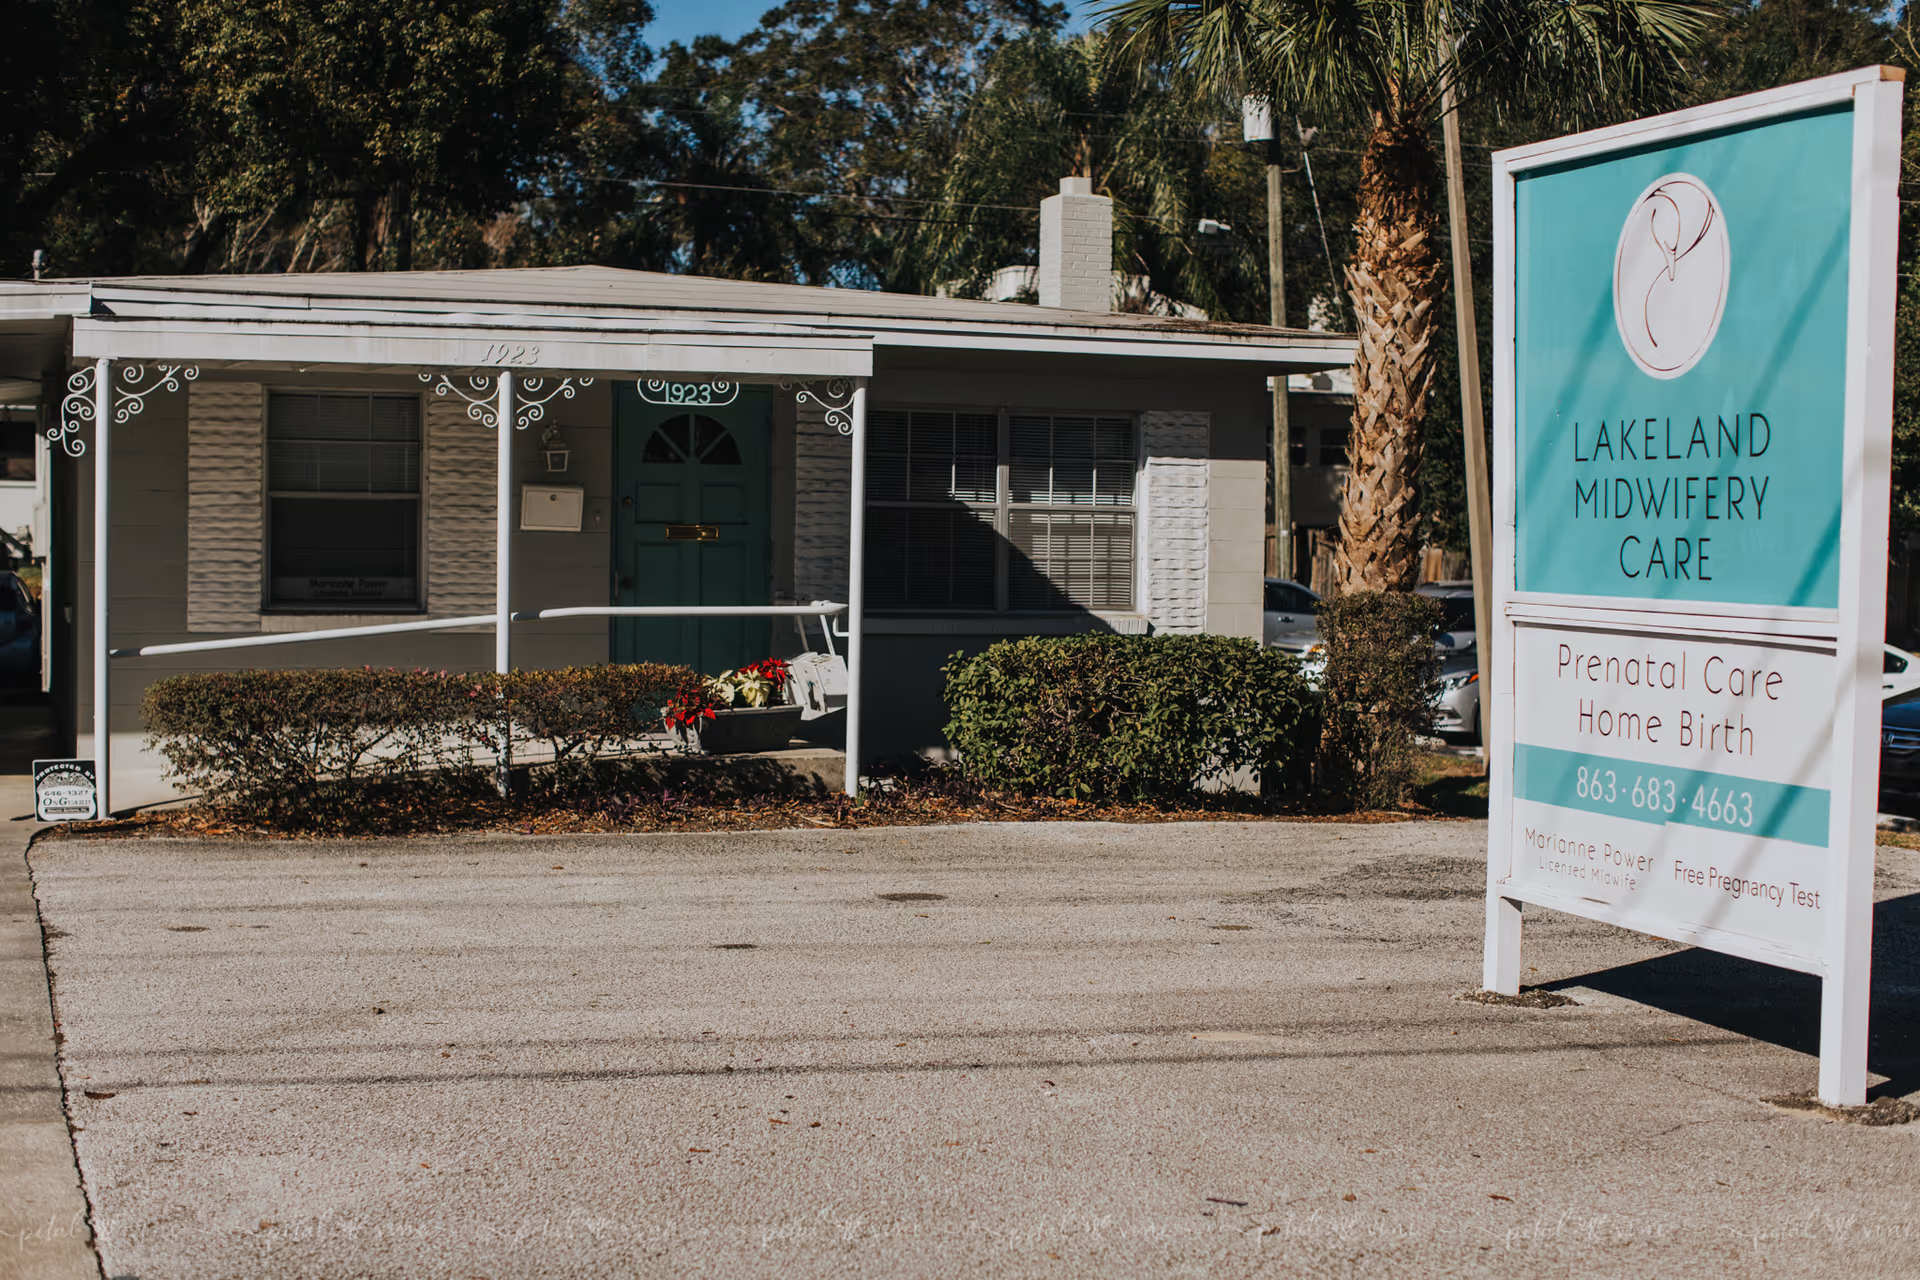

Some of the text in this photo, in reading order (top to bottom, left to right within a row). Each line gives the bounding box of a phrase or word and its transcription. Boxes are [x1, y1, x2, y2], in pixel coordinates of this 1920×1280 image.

[480, 344, 540, 365] 1923
[665, 383, 711, 404] 1923
[1575, 412, 1771, 462] LAKELAND
[1575, 476, 1770, 520] MIDWIFERY
[1619, 535, 1712, 580] CARE
[1558, 643, 1783, 701] Prenatal Care
[1579, 698, 1754, 756] Home Birth
[36, 763, 81, 781] PROTECTED
[1525, 827, 1654, 872] Marianne Power
[1540, 856, 1637, 891] Licensed Midwife
[1674, 860, 1820, 909] Free Pregnancy Test
